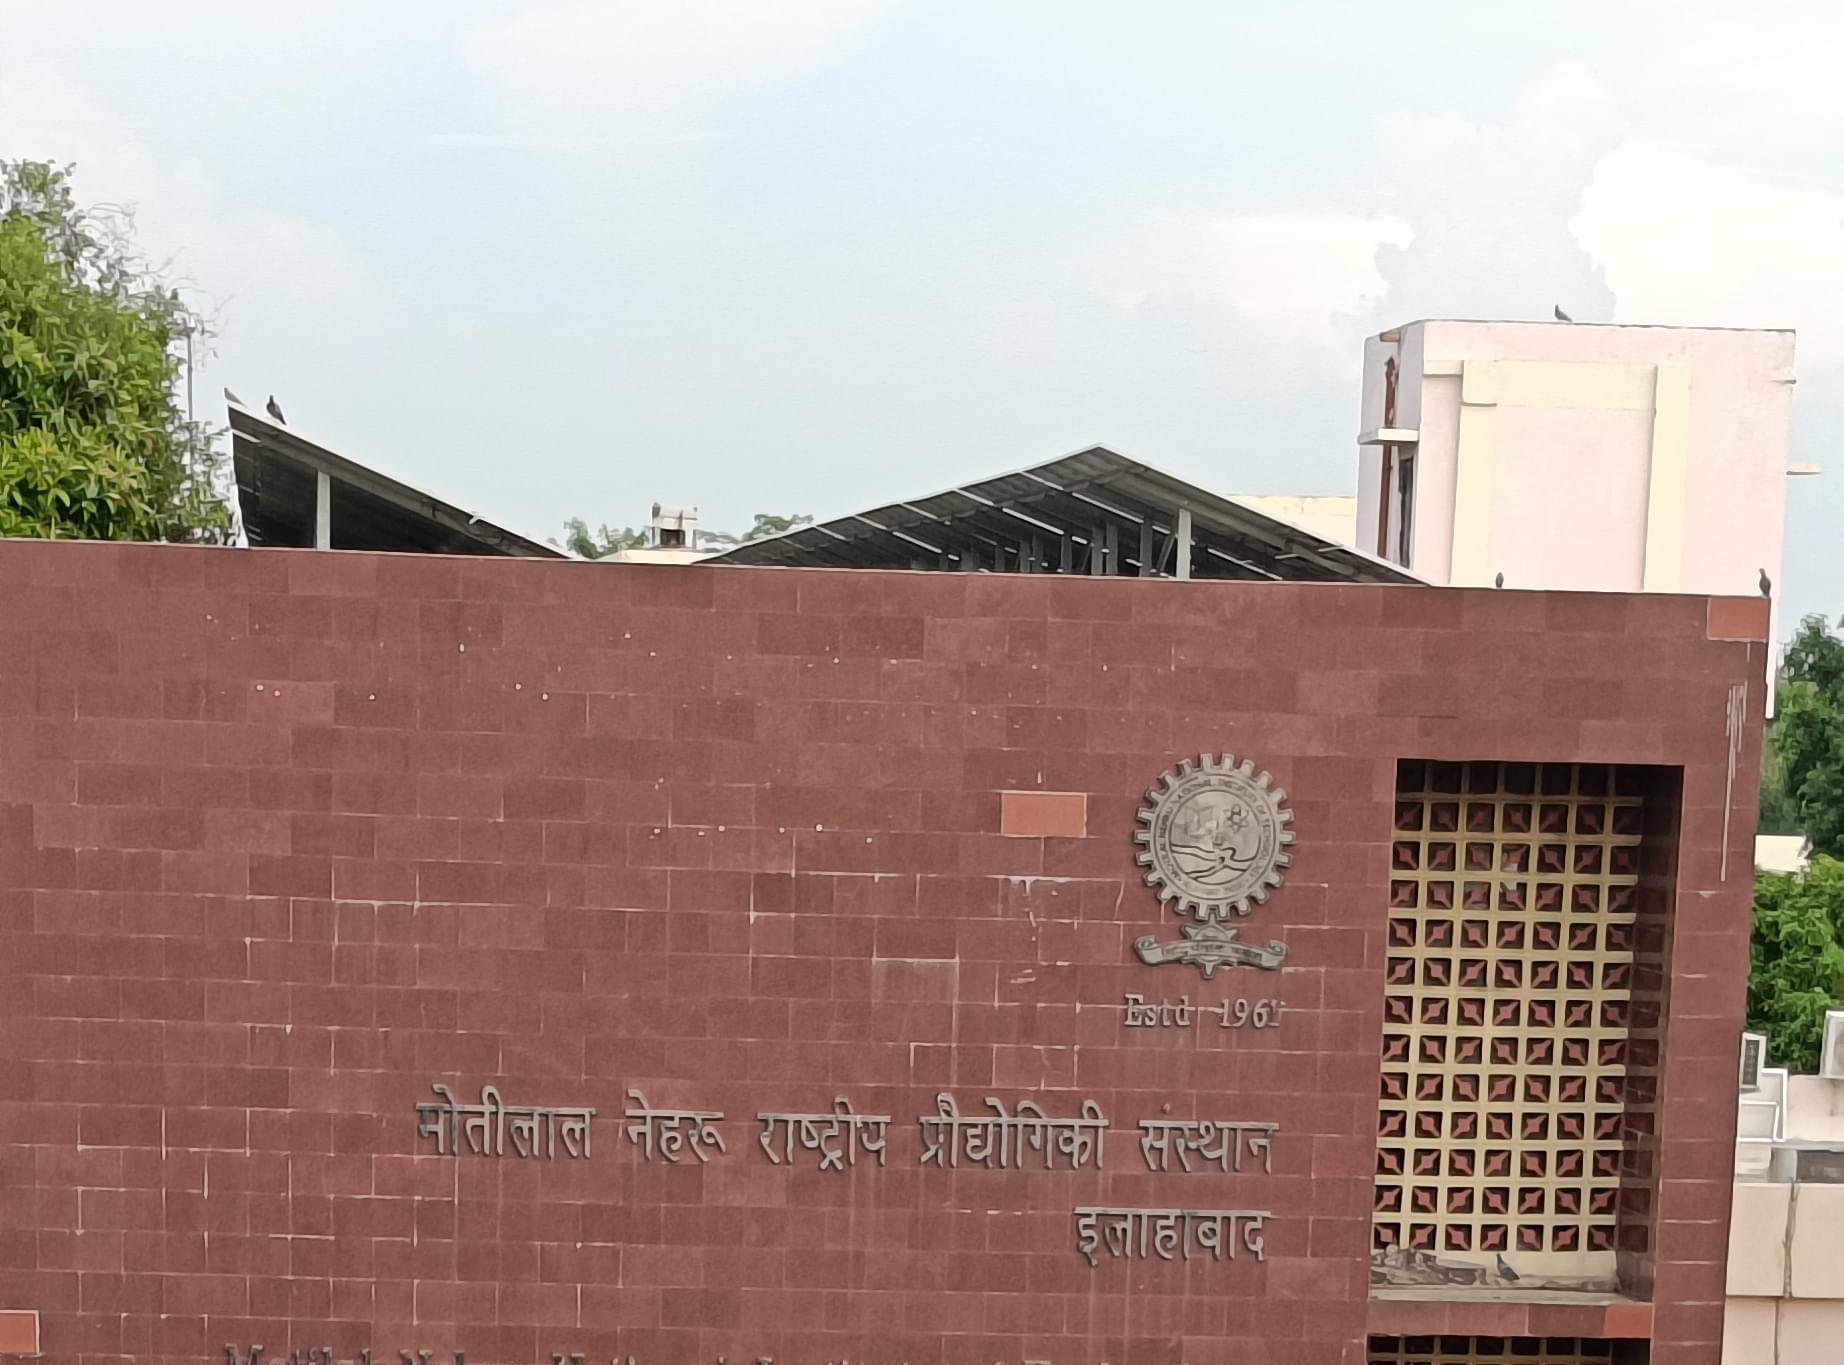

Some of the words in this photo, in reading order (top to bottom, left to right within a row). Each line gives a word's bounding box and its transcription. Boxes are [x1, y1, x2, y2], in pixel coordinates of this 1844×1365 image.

[1124, 994, 1190, 1027] Estd
[416, 1084, 596, 1160] मोतीलाल
[625, 1088, 726, 1162] नेहरू
[757, 1095, 891, 1170] राष्ट्रीय
[918, 1092, 1109, 1169] प्रौद्योगिकी
[1139, 1103, 1279, 1174] संस्थान
[1073, 1207, 1272, 1267] इलाहाबाद
